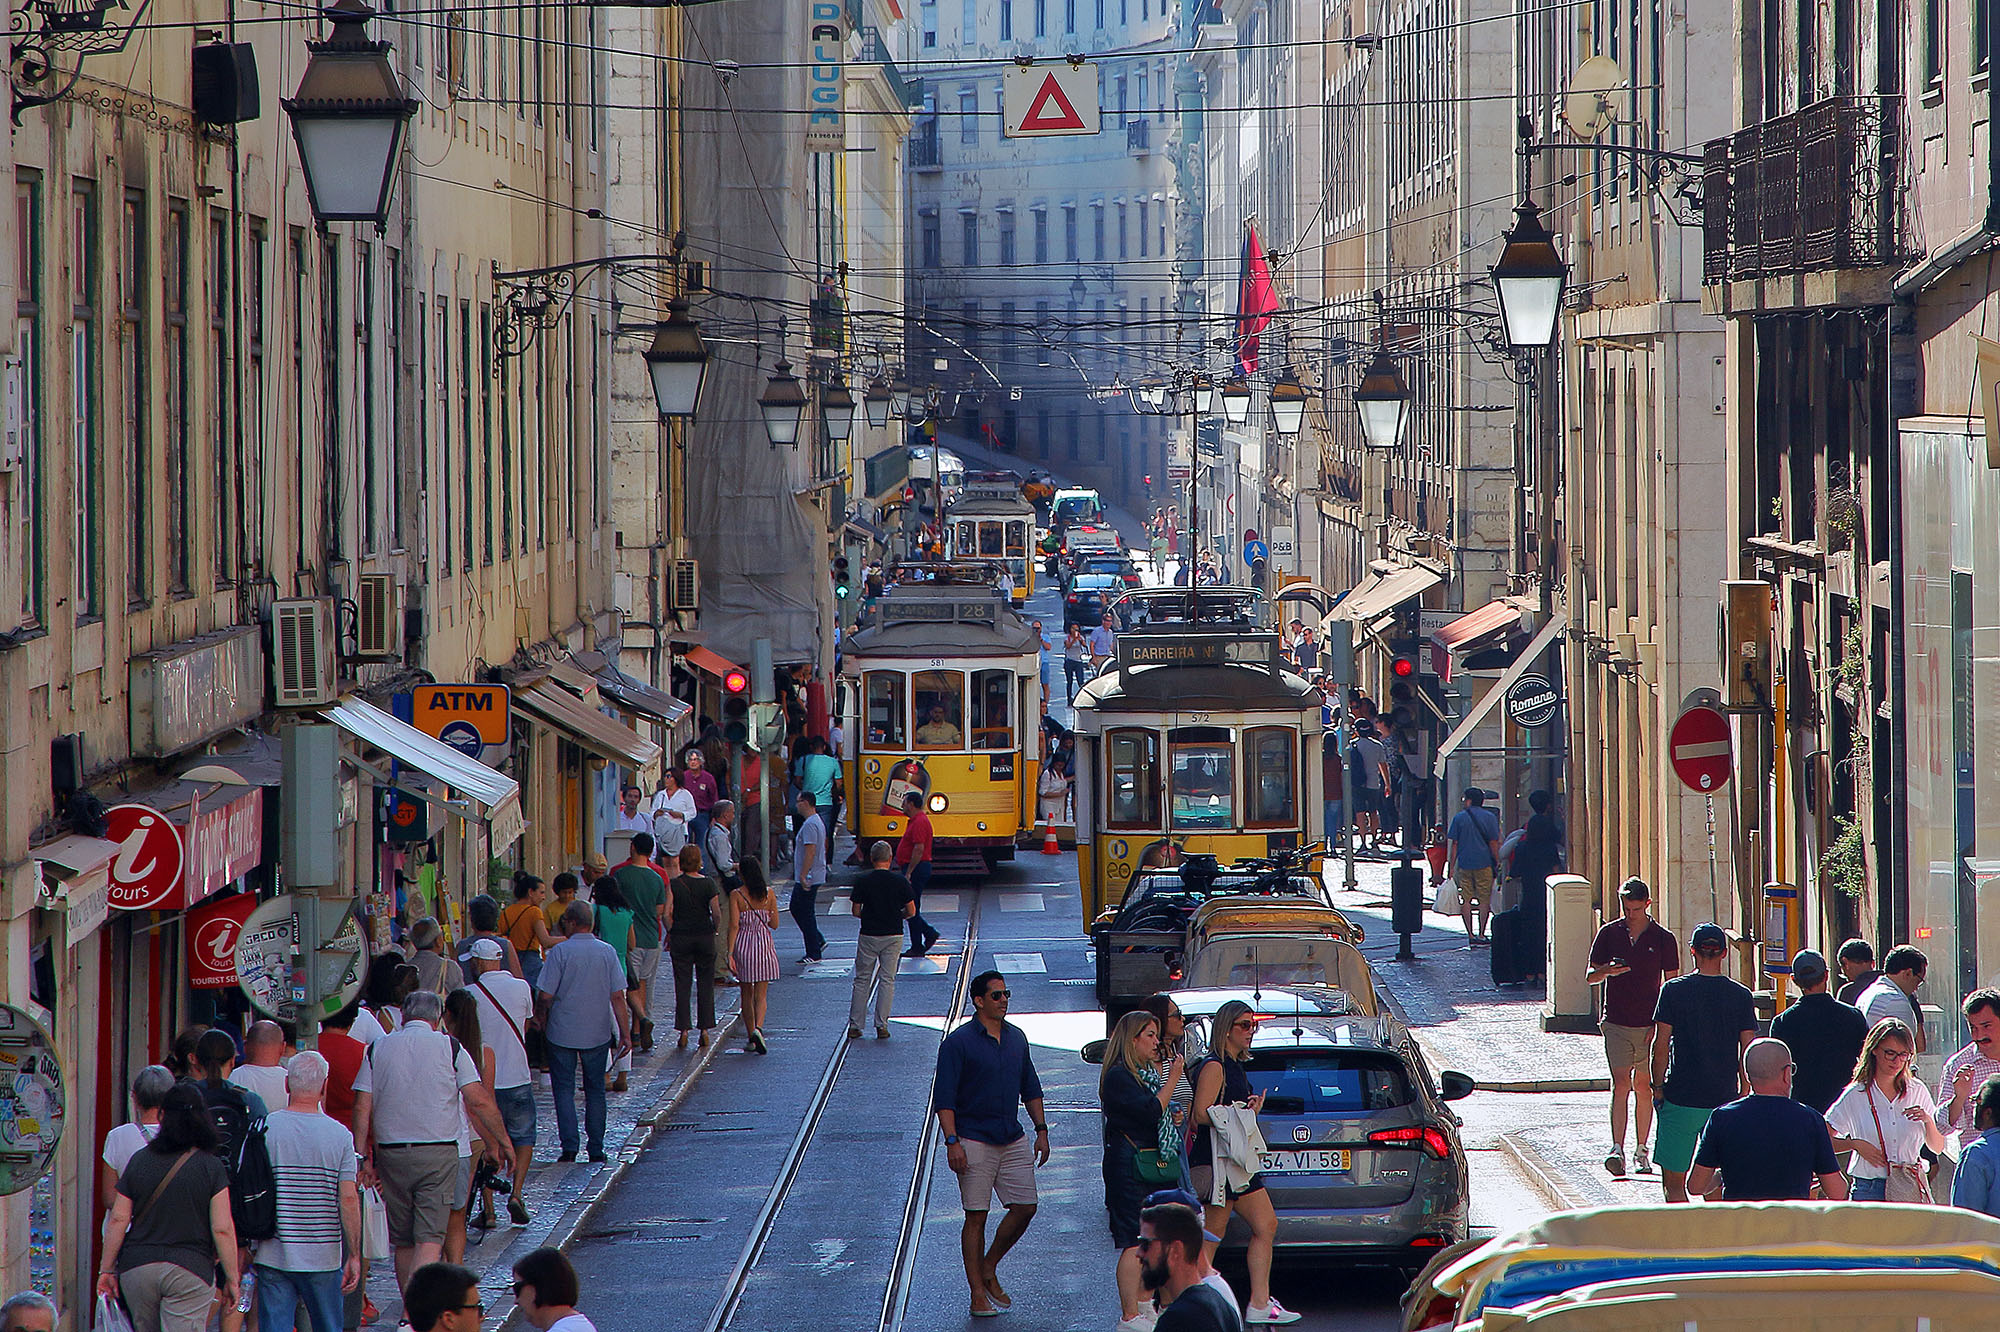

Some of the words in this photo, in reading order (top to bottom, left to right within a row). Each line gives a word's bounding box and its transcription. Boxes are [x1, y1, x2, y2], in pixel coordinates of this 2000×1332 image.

[1272, 542, 1292, 552] P&B
[963, 605, 985, 617] 28
[1132, 647, 1195, 660] CARREIRA
[931, 659, 945, 667] 581
[429, 692, 493, 711] ATM
[1510, 690, 1557, 713] Romana
[191, 976, 225, 986] TOURIST
